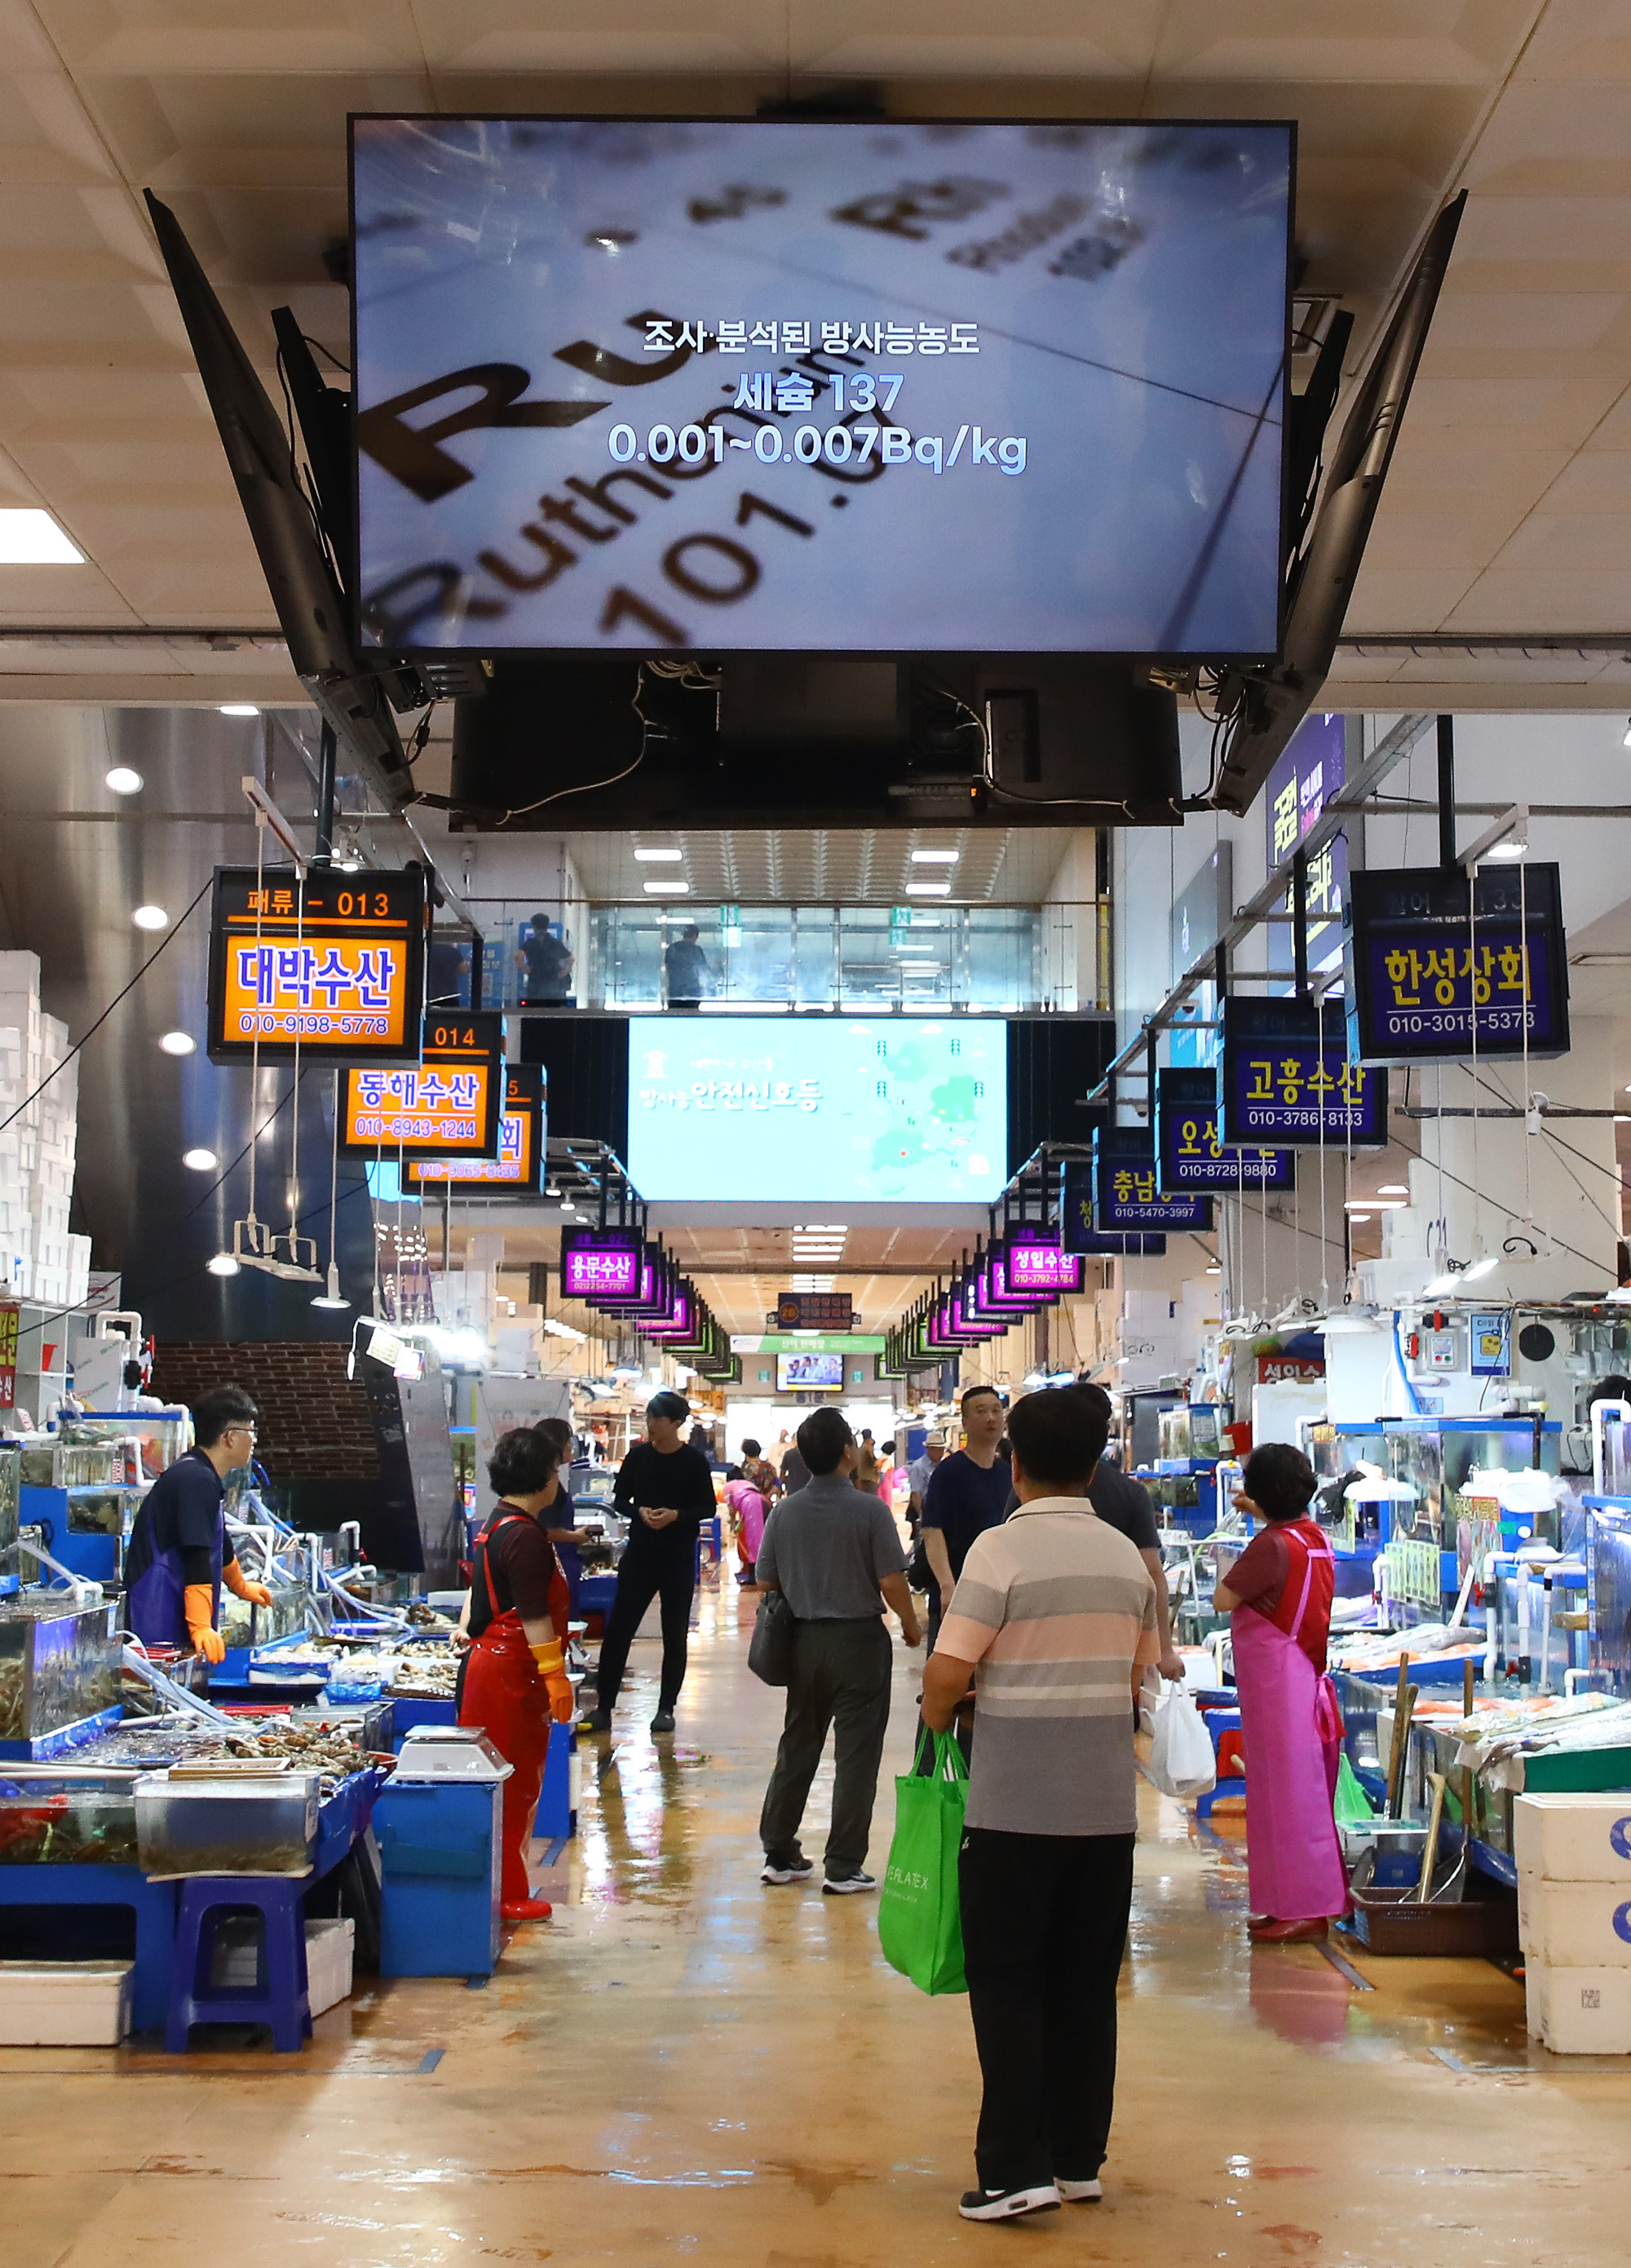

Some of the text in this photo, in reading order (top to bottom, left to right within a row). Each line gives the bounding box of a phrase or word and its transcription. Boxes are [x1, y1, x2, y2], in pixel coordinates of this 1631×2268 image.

[820, 321, 980, 355] 방사능농도
[733, 372, 905, 413] 세슘 137
[608, 424, 1028, 475] 0.001~0.007Bq/kg
[247, 889, 294, 916] 패류
[337, 891, 390, 917] 013
[236, 945, 397, 1009] 대박수산
[1385, 944, 1533, 1006] 한성상회
[239, 1015, 390, 1035] 010-9198-5778
[434, 1026, 475, 1046] 014
[1389, 1012, 1536, 1034] 010-3015-5373
[357, 1070, 481, 1111] 동해수산
[691, 1077, 823, 1112] 안전신호등
[1246, 1058, 1368, 1106] 고흥수산
[355, 1116, 477, 1139] 010-8943-1244
[1248, 1109, 1364, 1127] 010-3786-8133
[1179, 1164, 1277, 1177] 010-8728-9880
[1115, 1207, 1195, 1218] 010-5470-3997
[570, 1254, 632, 1280] 용문수산
[1014, 1250, 1075, 1270] 성일수산
